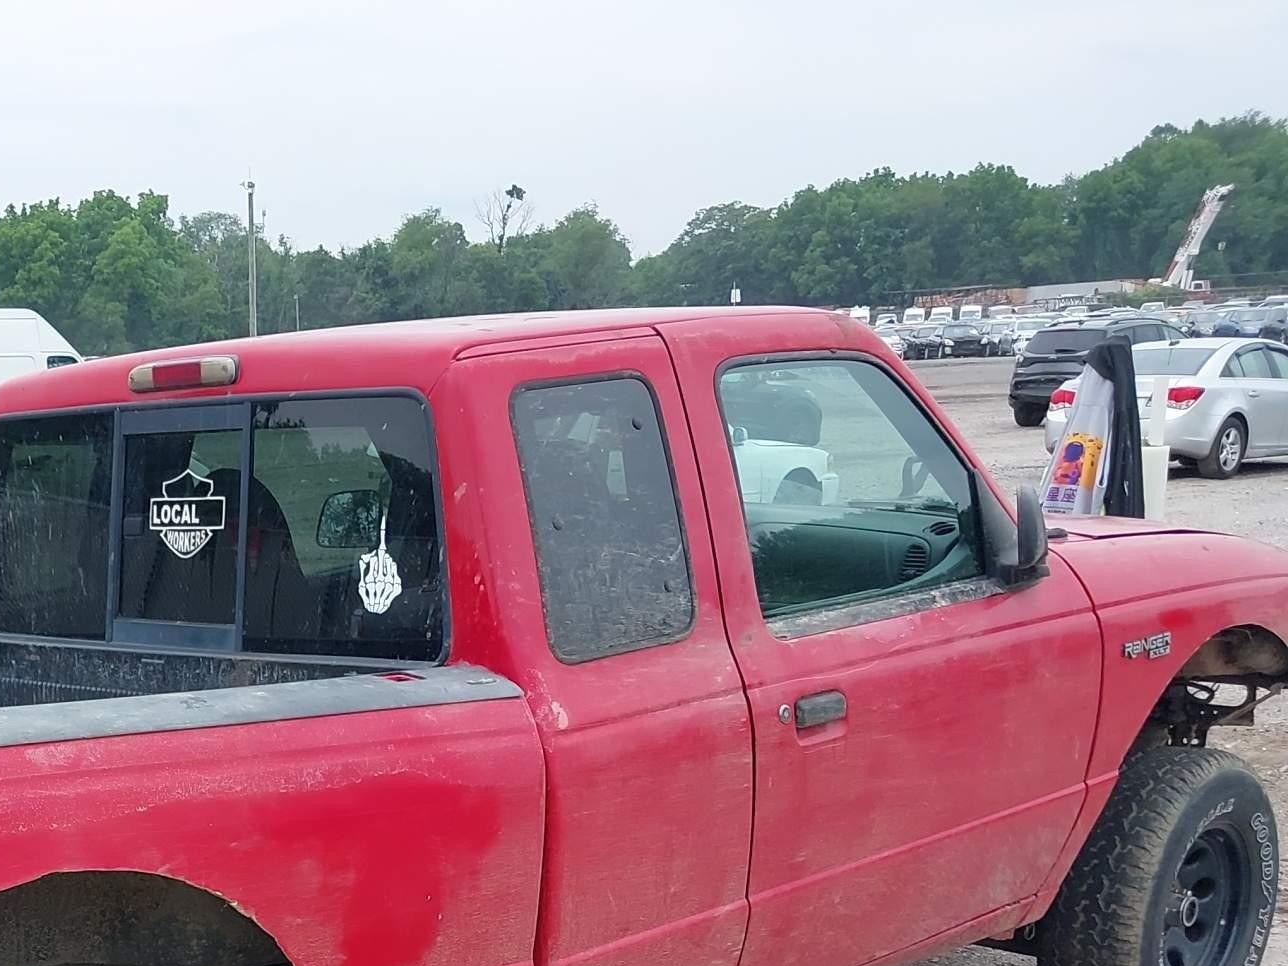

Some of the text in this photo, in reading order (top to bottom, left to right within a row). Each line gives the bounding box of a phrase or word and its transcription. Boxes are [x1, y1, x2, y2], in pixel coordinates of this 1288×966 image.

[152, 503, 200, 524] LOCAL
[166, 530, 206, 553] WORKERS
[1124, 632, 1171, 658] RANGER
